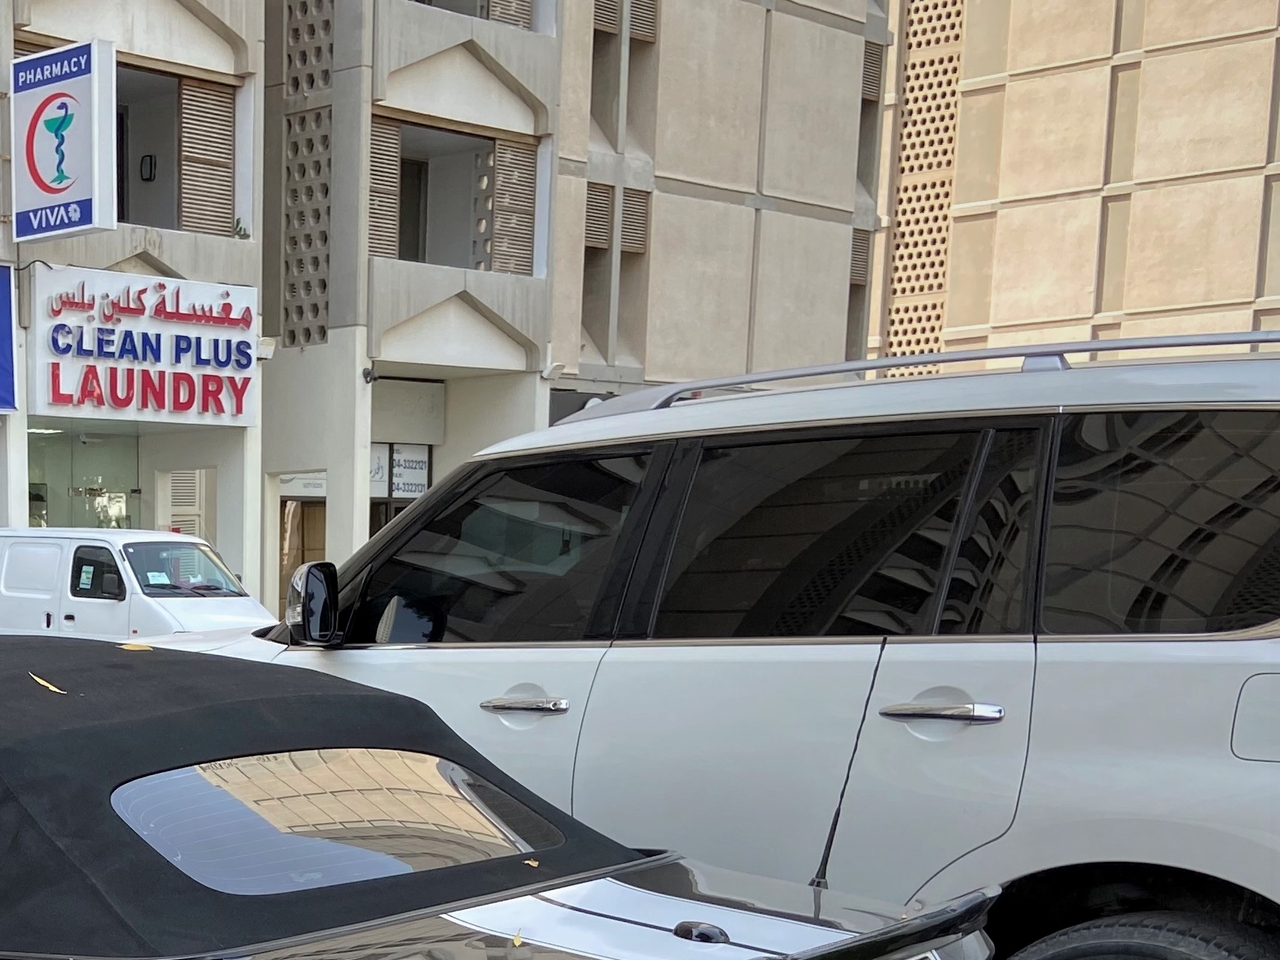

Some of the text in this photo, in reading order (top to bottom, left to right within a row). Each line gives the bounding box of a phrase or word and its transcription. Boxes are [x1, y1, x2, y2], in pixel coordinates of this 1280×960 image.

[18, 54, 87, 87] PHARMACY
[29, 205, 69, 229] VIVA
[48, 280, 253, 331] مغسلة كلين بلس
[50, 323, 252, 370] CLEAN PLUS
[48, 362, 252, 415] LAUNDRY
